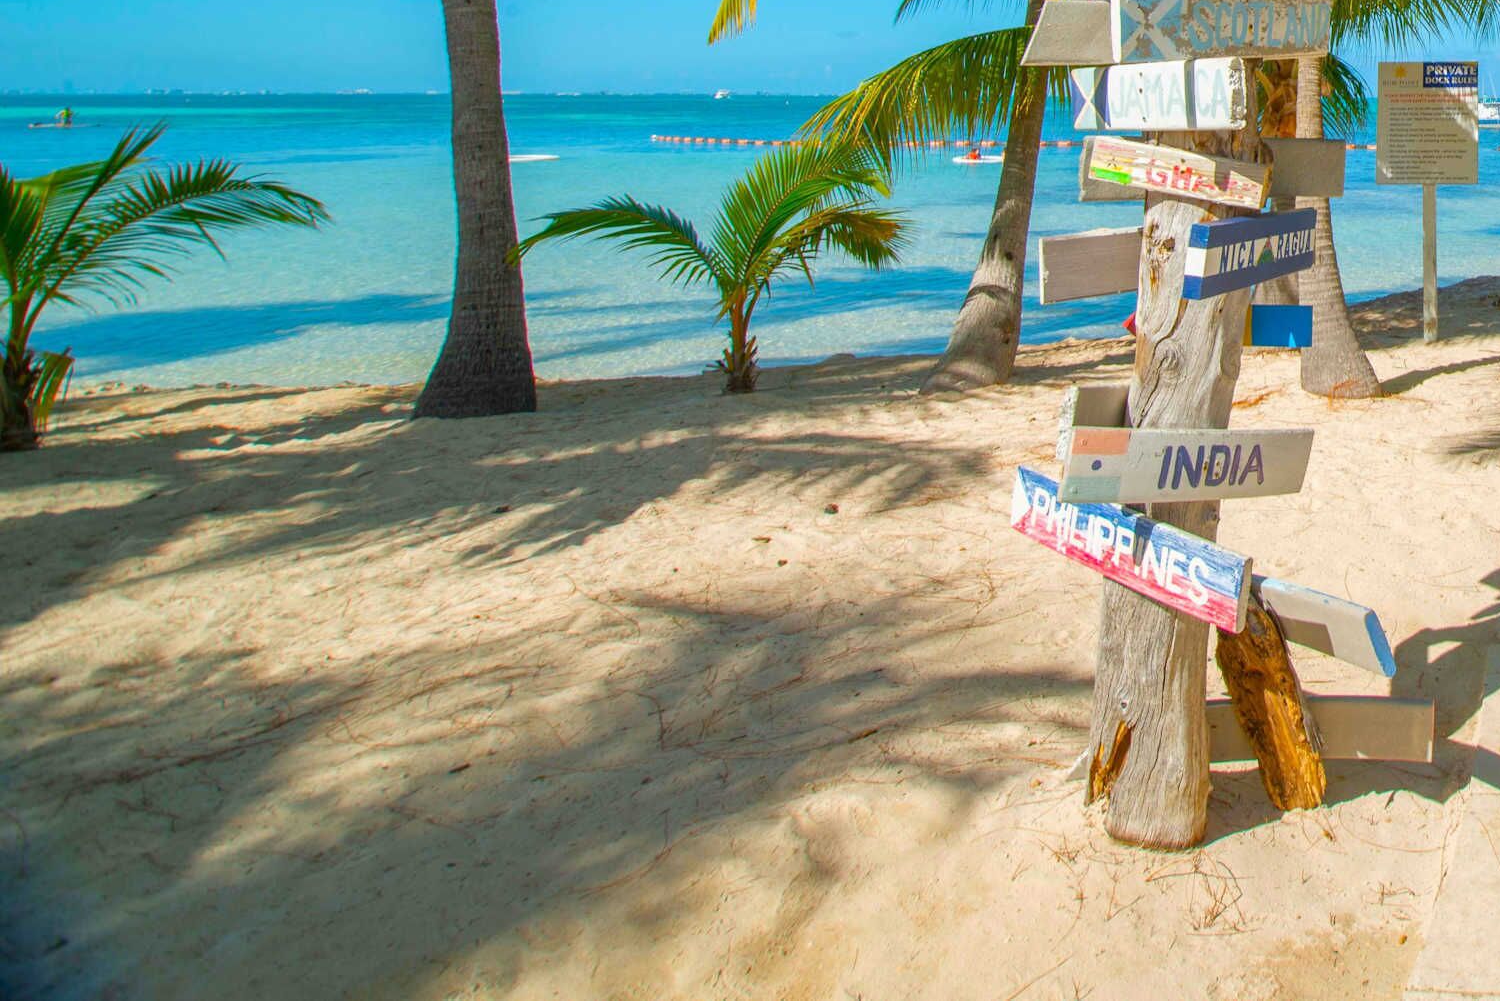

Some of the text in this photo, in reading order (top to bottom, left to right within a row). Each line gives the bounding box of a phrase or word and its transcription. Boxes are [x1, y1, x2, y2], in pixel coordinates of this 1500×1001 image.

[1425, 76, 1450, 85] DOCK
[1451, 76, 1477, 85] RULES
[1426, 65, 1477, 76] PRIVATE
[1158, 444, 1265, 490] INDIA
[1030, 488, 1210, 607] PHILIPPINES
